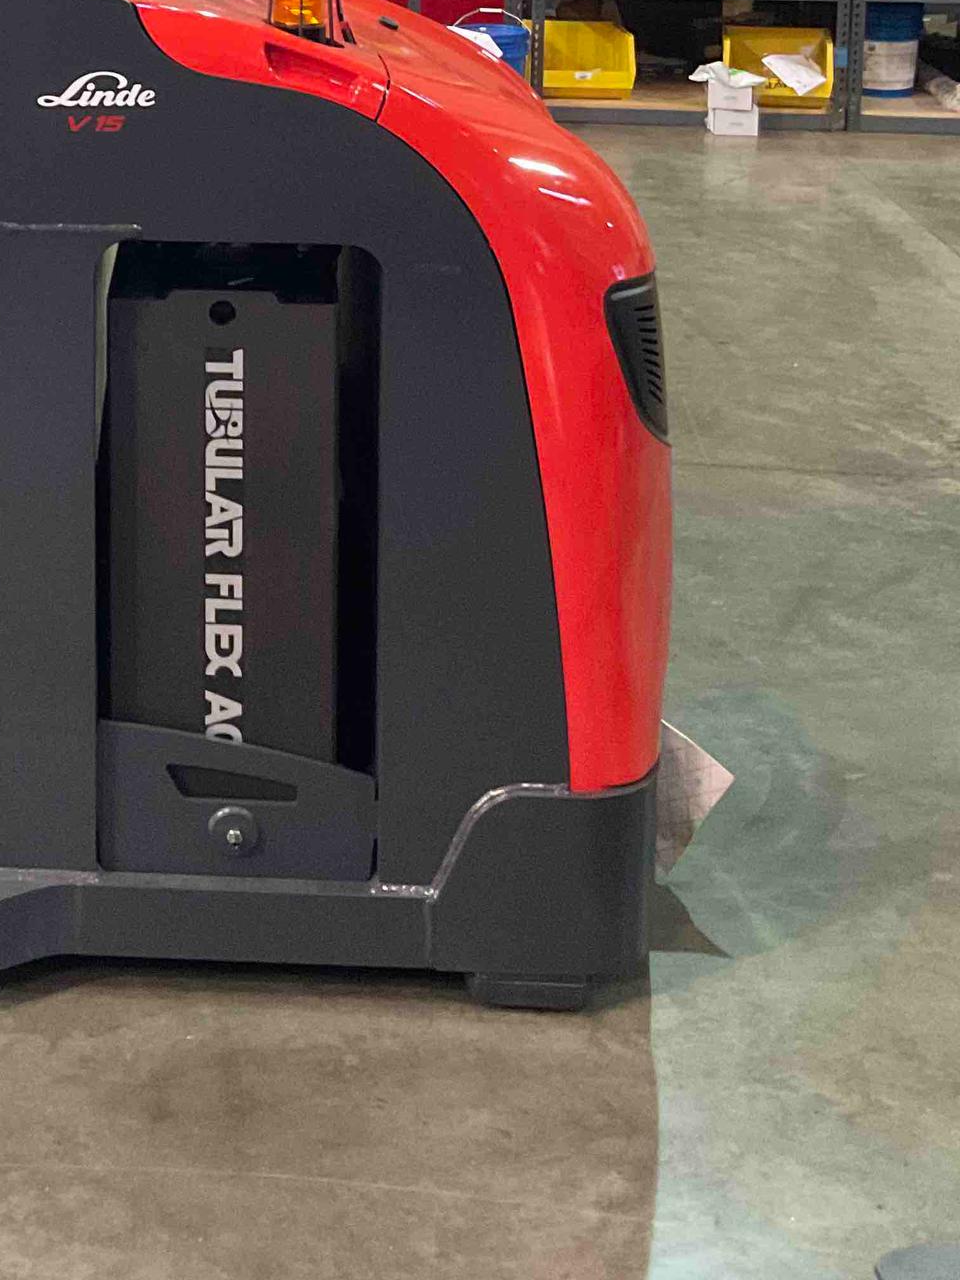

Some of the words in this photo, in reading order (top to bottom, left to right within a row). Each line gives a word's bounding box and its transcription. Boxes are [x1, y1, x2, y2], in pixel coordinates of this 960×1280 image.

[36, 71, 156, 107] Linde
[205, 349, 244, 558] TUBULAR
[205, 573, 243, 677] FLEX
